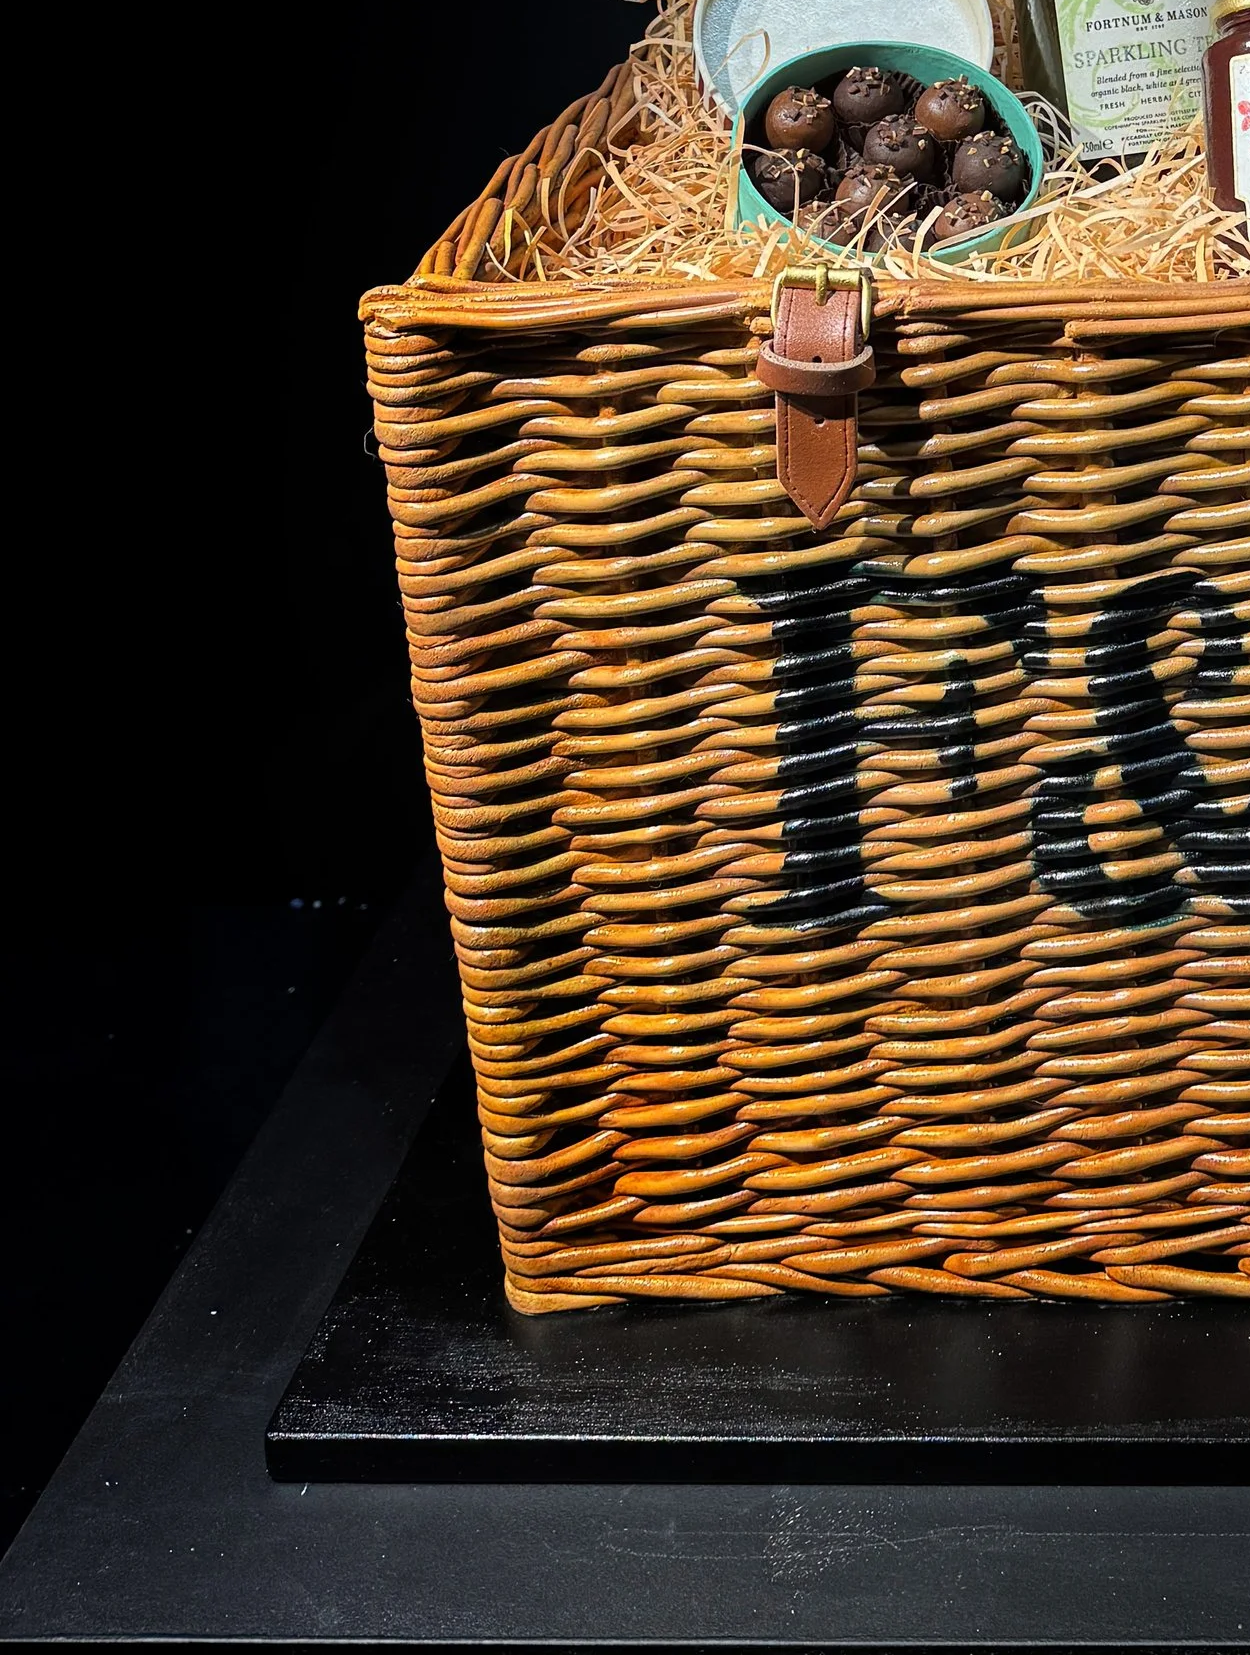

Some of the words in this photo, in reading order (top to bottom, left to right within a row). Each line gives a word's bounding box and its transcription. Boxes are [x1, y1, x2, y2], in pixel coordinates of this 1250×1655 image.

[1086, 13, 1151, 32] FORTNUM
[1155, 12, 1164, 22] &
[1167, 6, 1208, 21] MASON
[1073, 38, 1187, 69] SPARKLING
[1192, 35, 1214, 52] TE
[1097, 73, 1127, 85] Blended
[1129, 71, 1148, 82] from
[1156, 67, 1172, 78] fine
[1091, 88, 1120, 99] organic
[1121, 83, 1144, 93] black,
[1146, 80, 1168, 90] white
[1185, 77, 1201, 86] gree
[1100, 101, 1126, 110] FRESH
